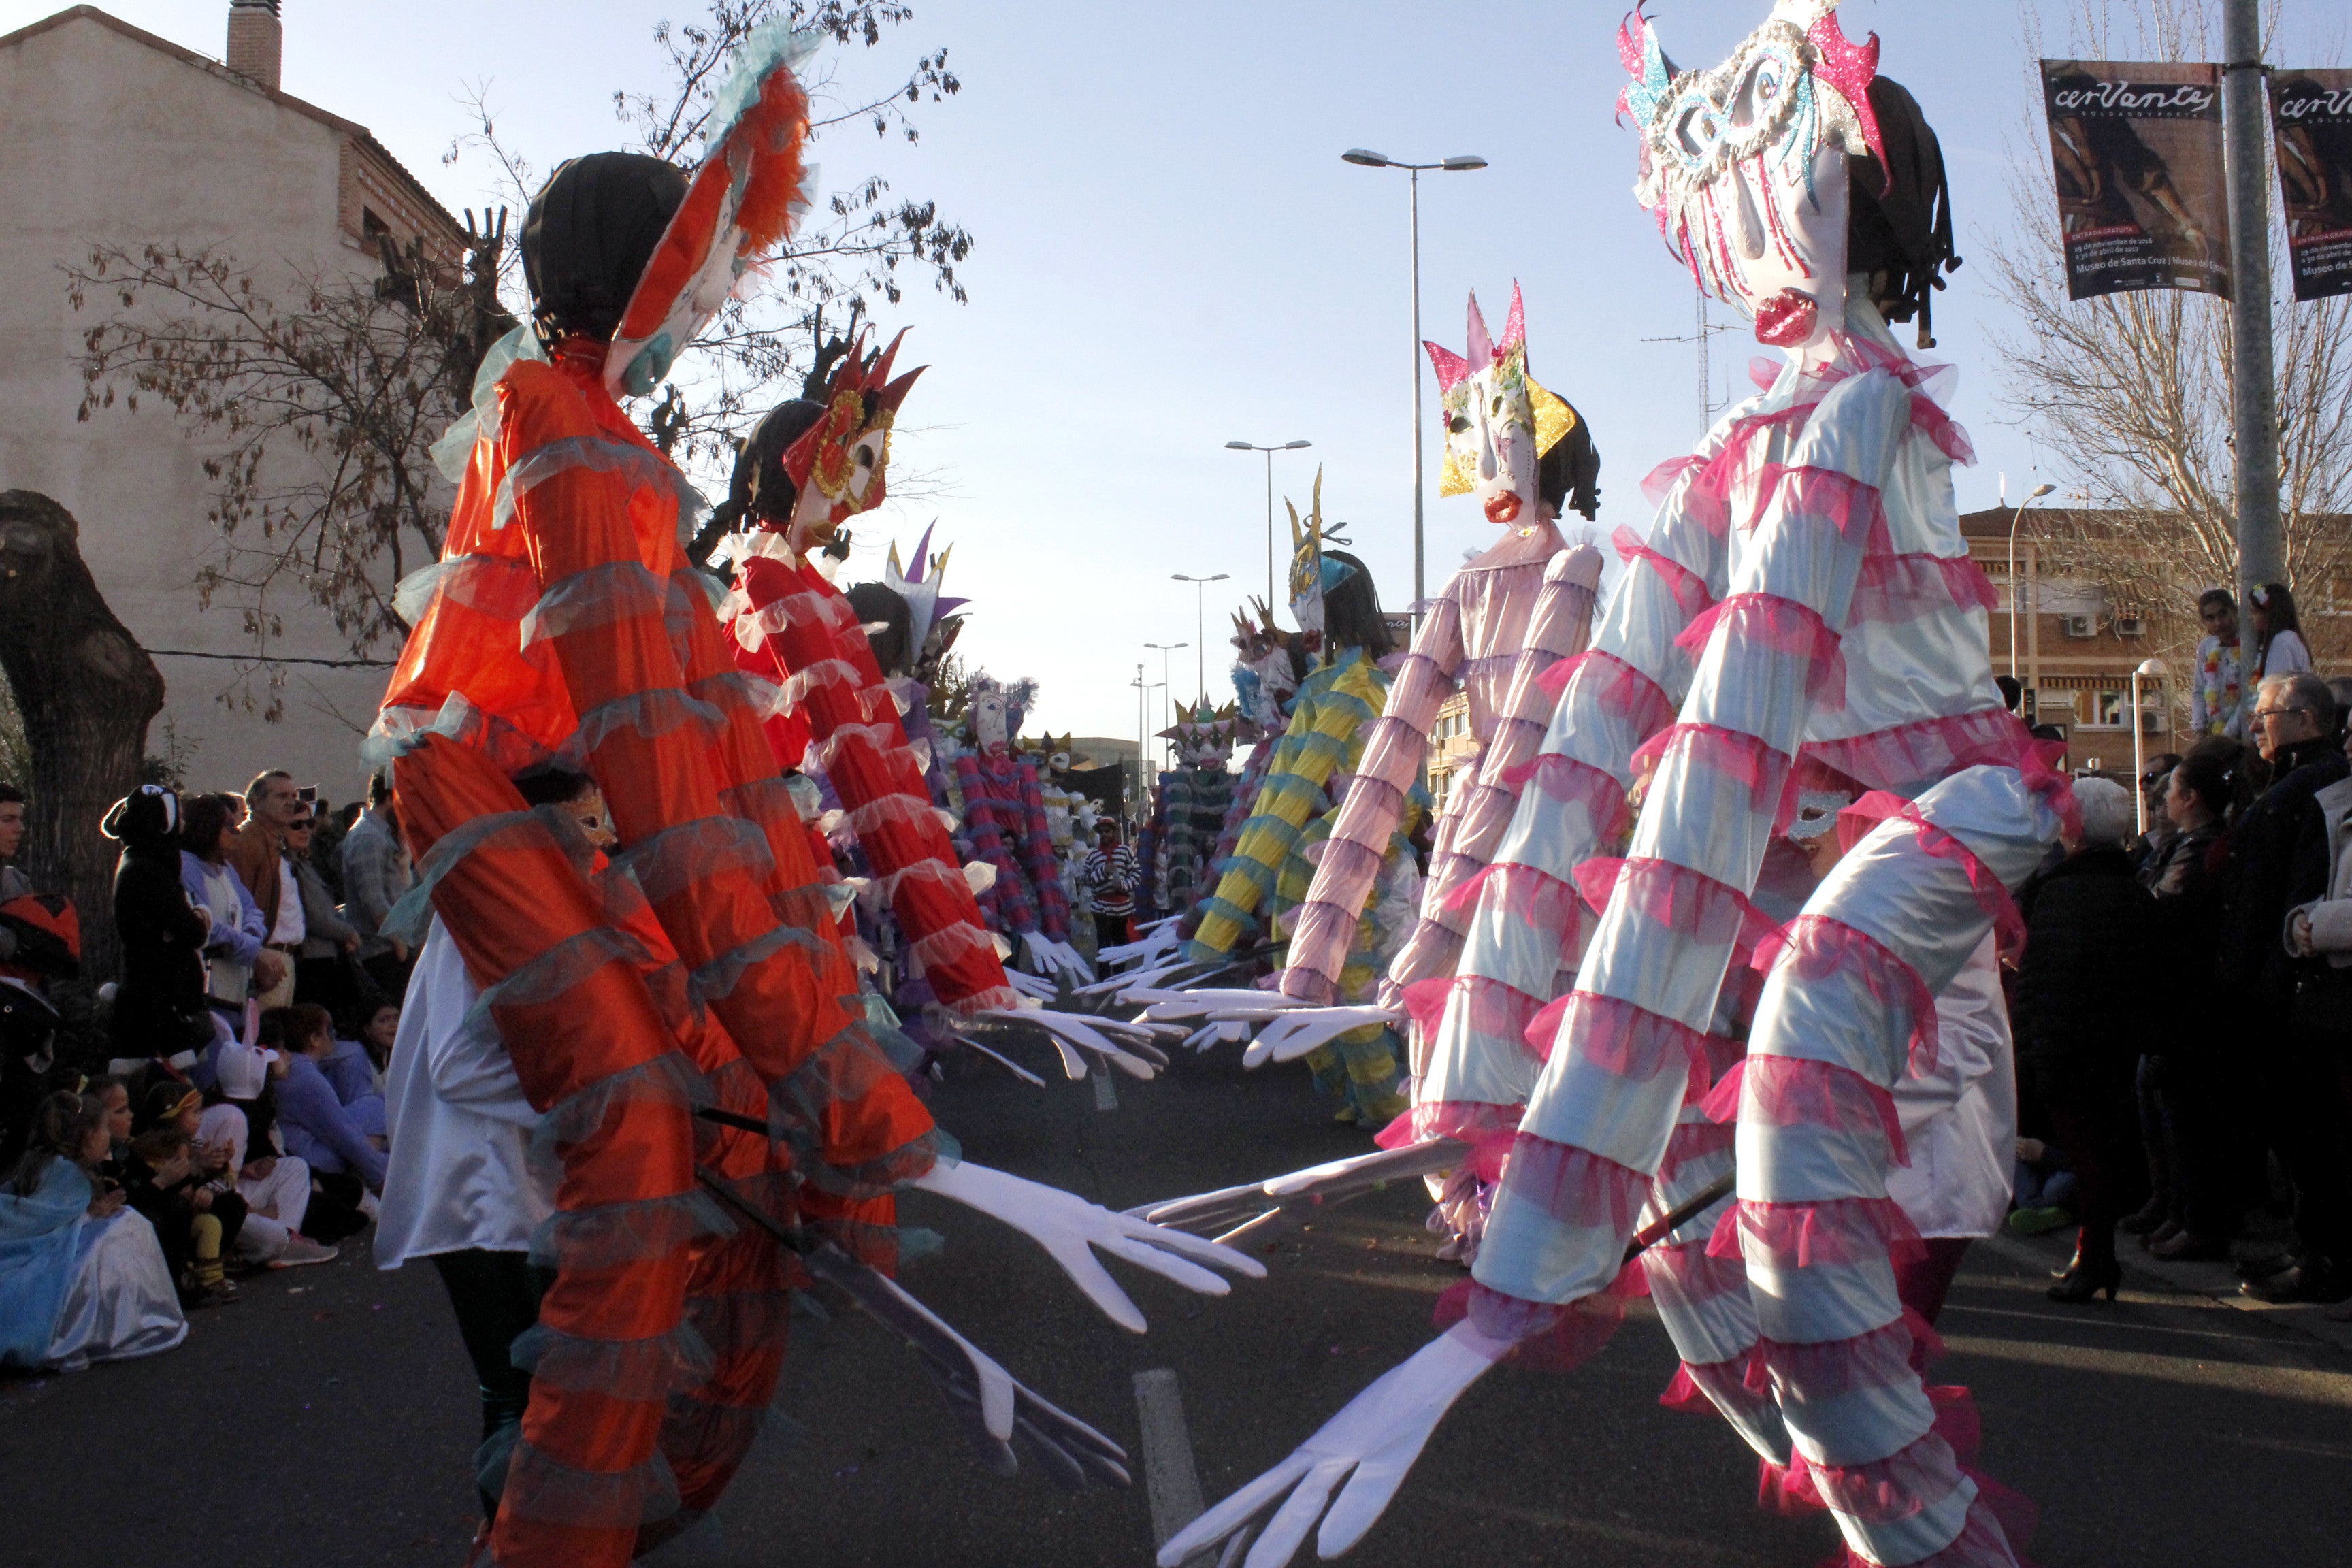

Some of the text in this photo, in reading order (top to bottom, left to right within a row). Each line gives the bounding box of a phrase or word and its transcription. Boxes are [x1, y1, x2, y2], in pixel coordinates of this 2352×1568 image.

[2072, 230, 2102, 240] ENTRADA
[2298, 234, 2329, 244] ENTRADA
[2093, 239, 2127, 248] noviembre
[2327, 250, 2341, 258] abril
[2076, 261, 2106, 274] Museo
[2108, 259, 2119, 267] de
[2121, 258, 2146, 266] Santa
[2147, 256, 2167, 265] Cruz
[2172, 256, 2198, 267] Museo
[2302, 265, 2334, 276] Museo
[2336, 261, 2347, 270] de
